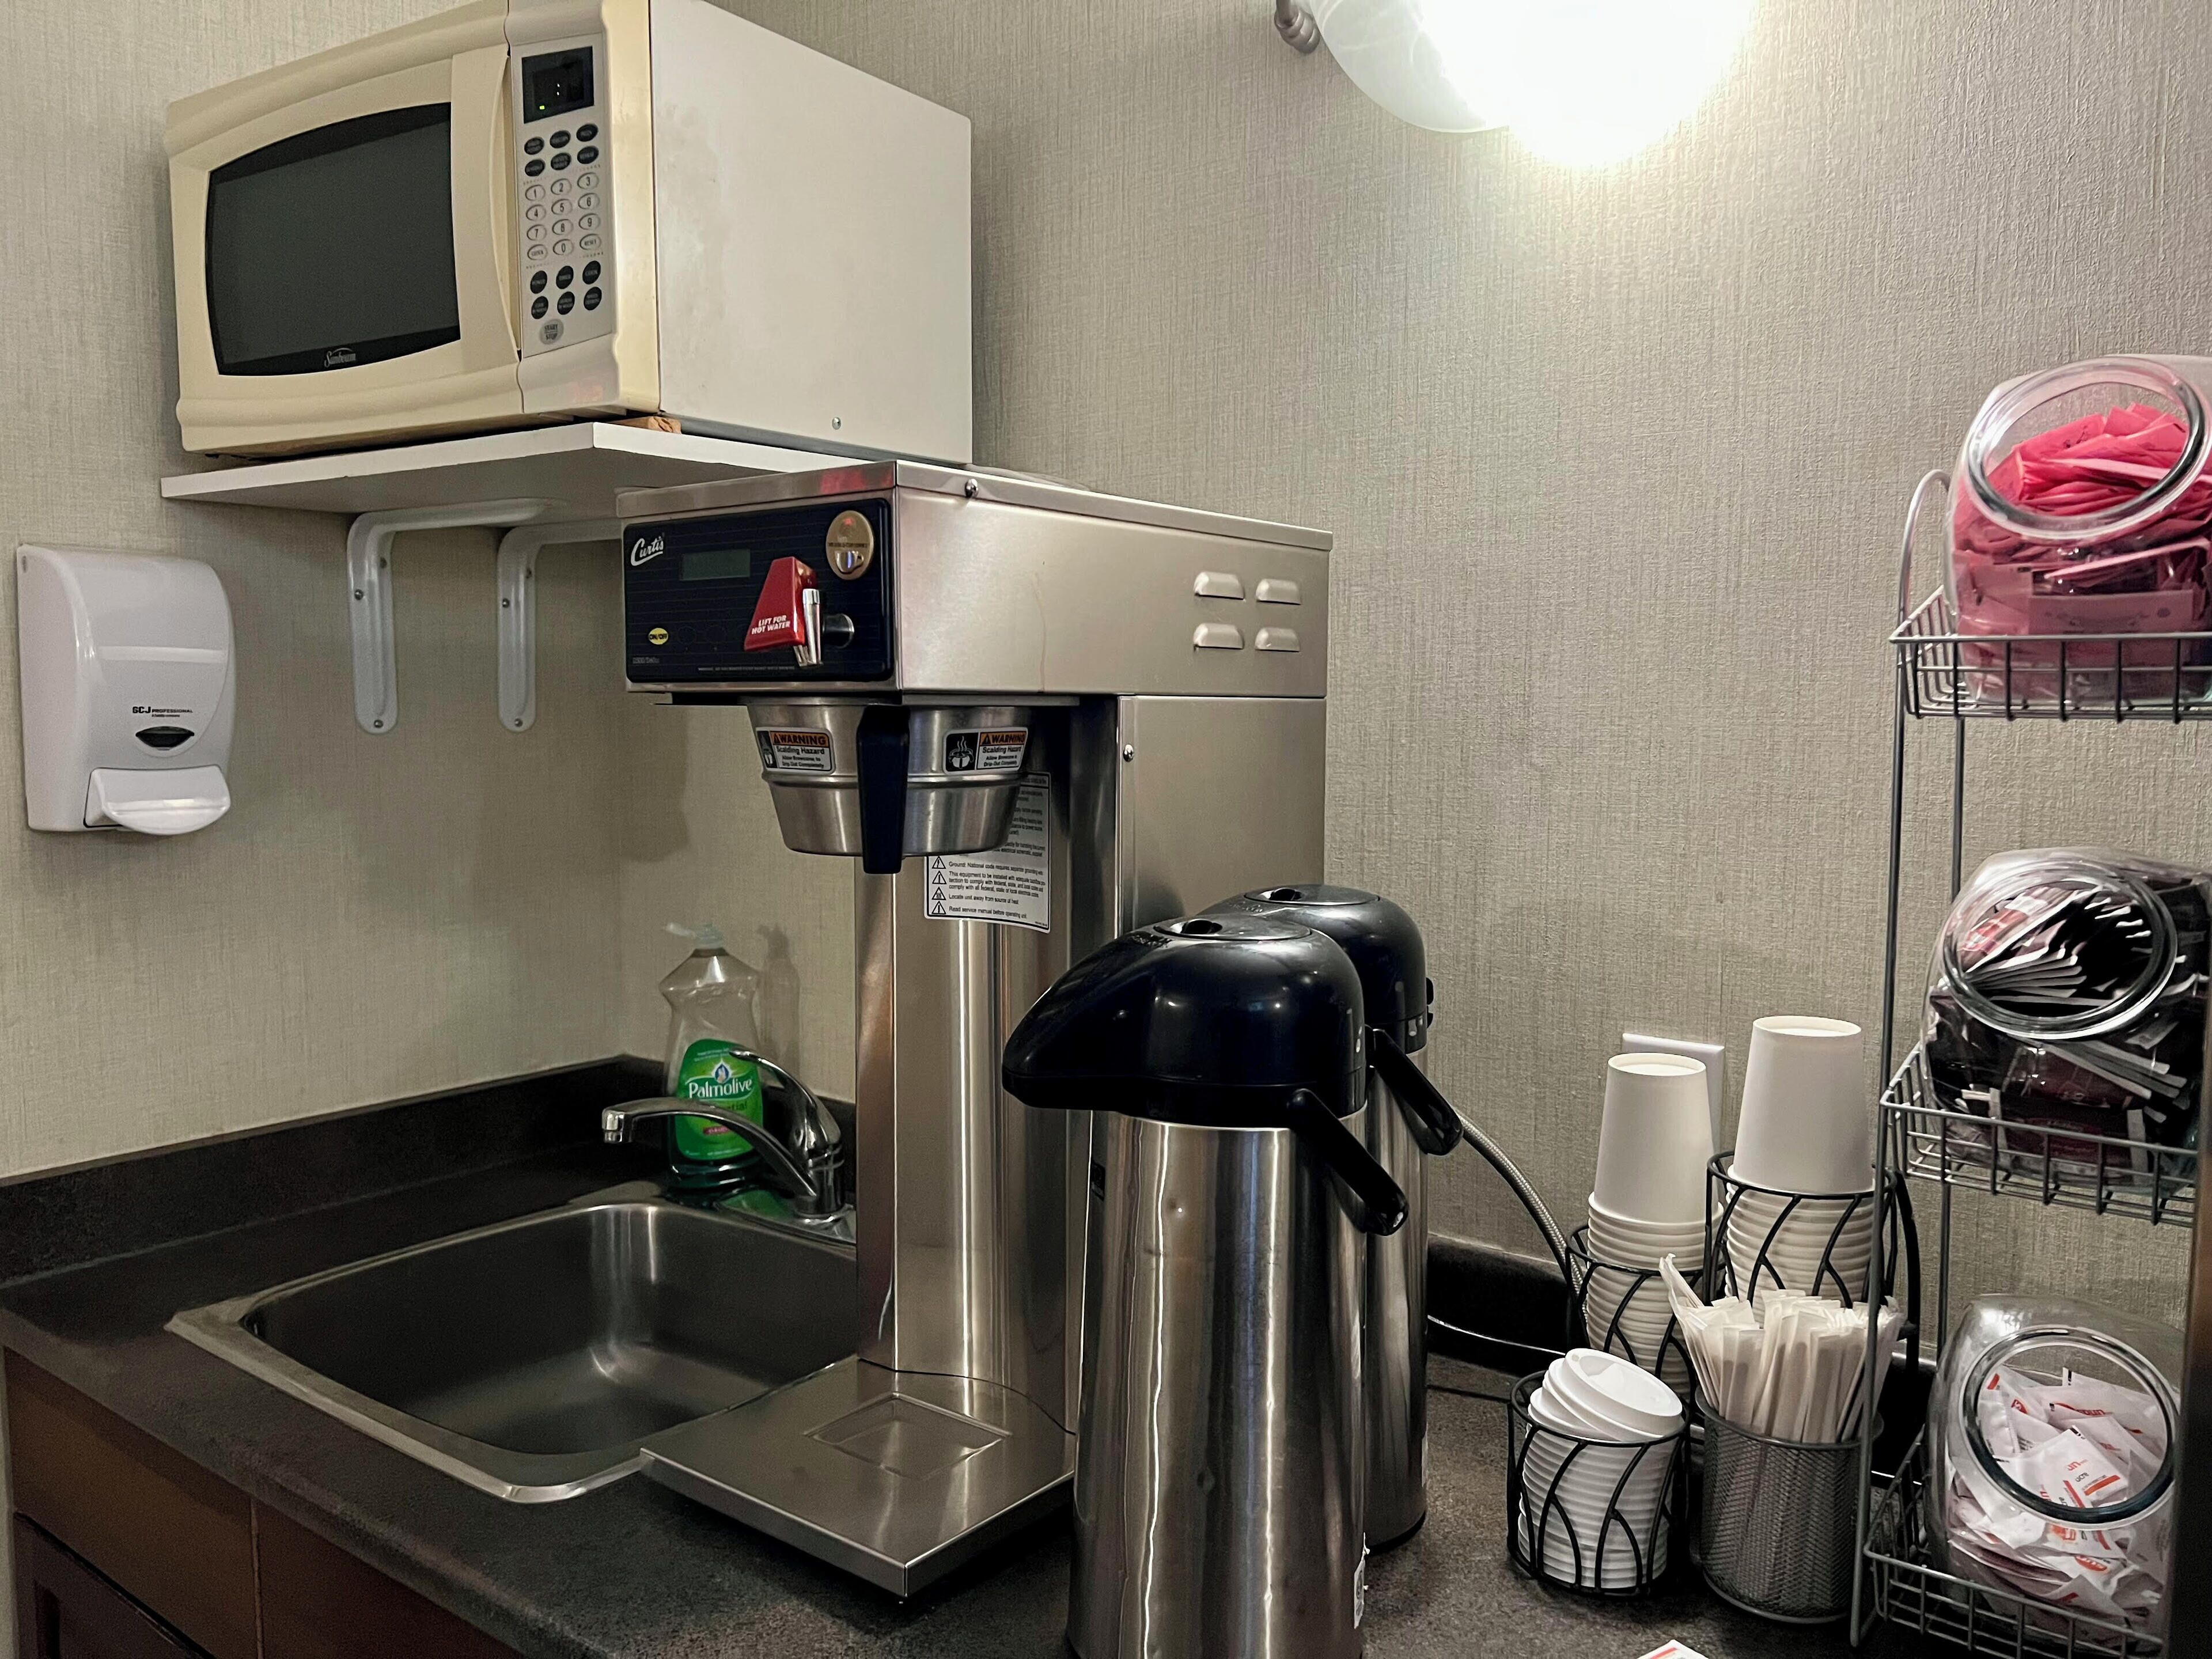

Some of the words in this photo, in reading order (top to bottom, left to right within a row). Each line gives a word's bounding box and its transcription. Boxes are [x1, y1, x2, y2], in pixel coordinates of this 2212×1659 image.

[586, 176, 591, 186] 3
[559, 183, 563, 192] 2
[533, 188, 537, 199] 1
[586, 196, 591, 207] 6
[534, 209, 539, 217] 4
[559, 203, 565, 213] 5
[560, 223, 565, 233] 8
[588, 217, 592, 228] 9
[535, 229, 539, 238] 7
[561, 243, 566, 253] 0
[324, 349, 356, 368] Sunbeam
[631, 536, 664, 566] Curtis
[758, 618, 772, 627] LIFT
[773, 615, 787, 624] FOR
[752, 625, 766, 635] HOT
[767, 621, 791, 631] WATER
[779, 734, 826, 745] WARNING
[777, 745, 800, 755] Scalding
[689, 1078, 752, 1099] Palmolive
